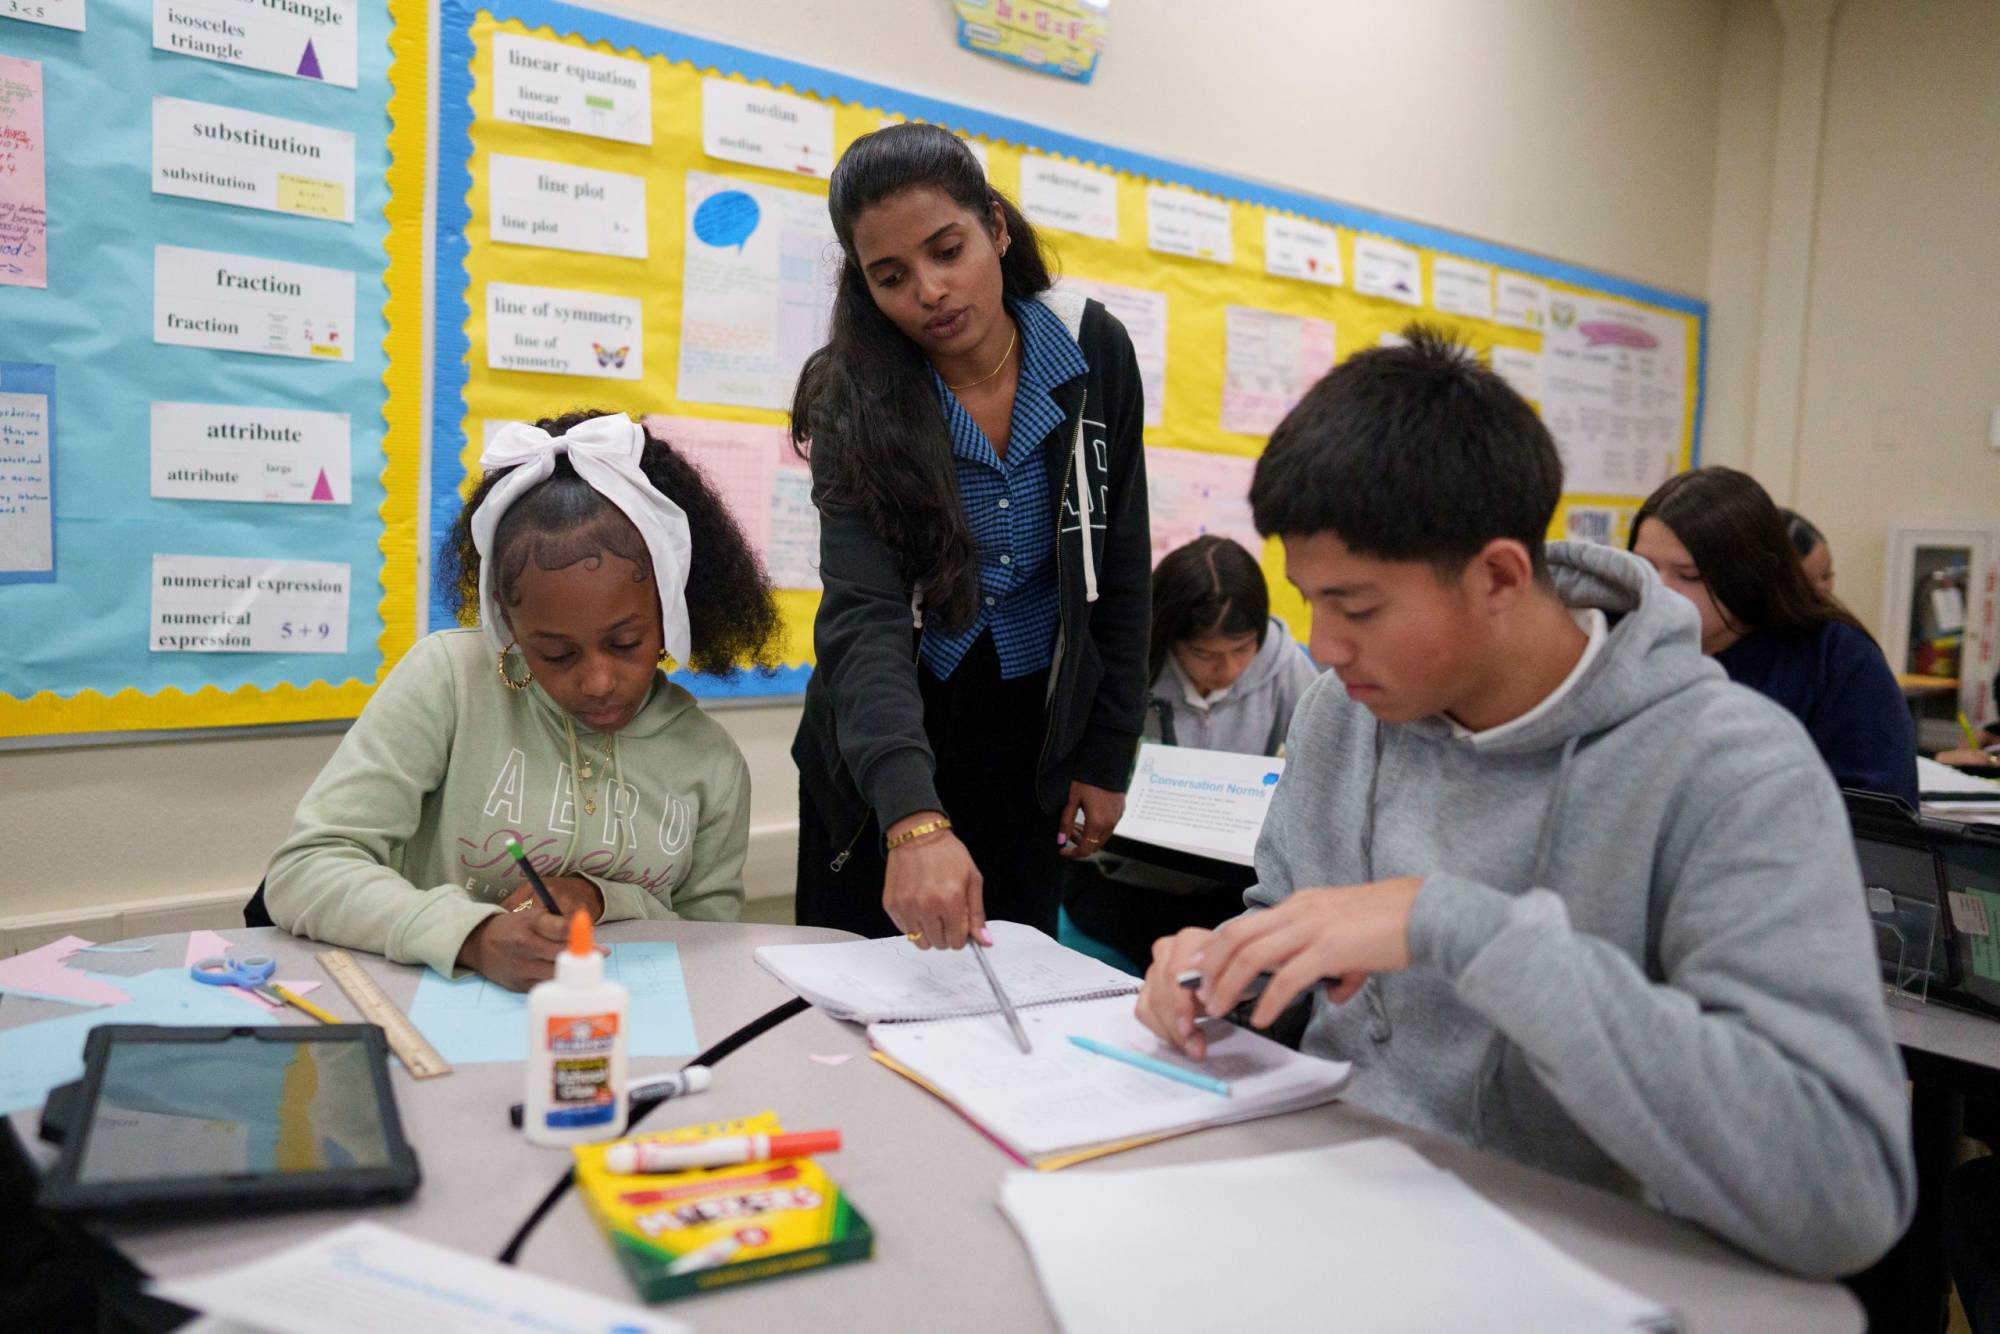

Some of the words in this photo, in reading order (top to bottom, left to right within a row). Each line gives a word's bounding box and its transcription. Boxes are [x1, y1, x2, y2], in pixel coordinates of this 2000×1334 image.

[168, 8, 245, 38] isosceles
[171, 33, 243, 60] triangle
[508, 50, 560, 73] linear
[566, 61, 637, 90] equation
[518, 86, 560, 105] linear
[509, 105, 570, 127] equation
[193, 120, 321, 159] substitution
[162, 166, 256, 193] substitution
[538, 175, 570, 194] line
[574, 181, 604, 200] plot
[502, 215, 527, 230] line
[532, 218, 558, 235] plot
[216, 269, 301, 297] fraction
[167, 313, 239, 336] fraction
[495, 298, 527, 315] line
[532, 299, 550, 317] of
[554, 306, 633, 330] symmetry
[514, 334, 539, 348] line
[542, 336, 557, 350] of
[501, 353, 570, 371] symmetry
[207, 422, 302, 443] attribute
[167, 468, 239, 484] attribute
[162, 575, 251, 590] numerical
[257, 580, 342, 596] expression
[162, 612, 251, 625] numerical
[158, 633, 251, 650] expression
[281, 623, 292, 639] 5
[301, 625, 313, 637] +
[319, 623, 330, 639] 9
[1150, 773, 1222, 792] Conversation
[1226, 782, 1265, 798] Norms
